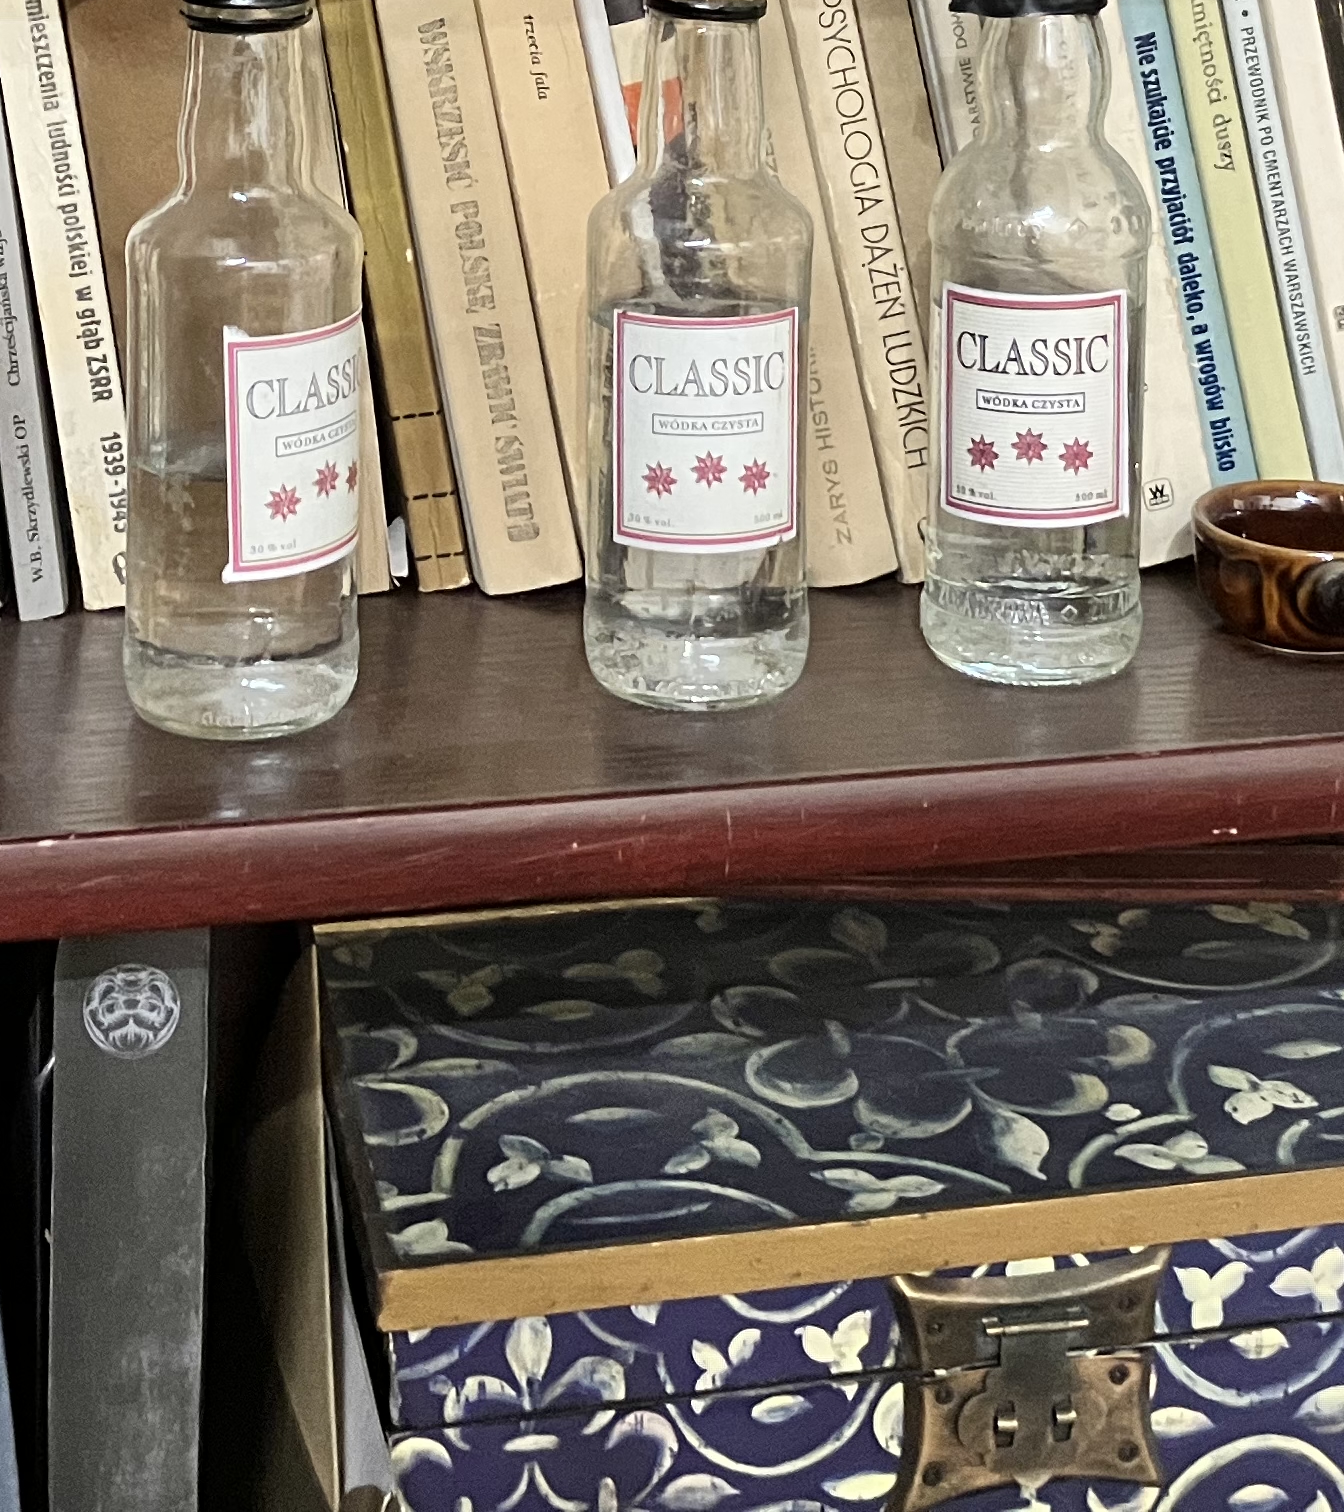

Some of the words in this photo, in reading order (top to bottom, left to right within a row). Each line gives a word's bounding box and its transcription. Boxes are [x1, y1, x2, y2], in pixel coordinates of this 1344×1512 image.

[523, 13, 543, 66] trzecia
[1133, 30, 1157, 66] Nie
[530, 71, 548, 101] fala
[1240, 25, 1270, 124] PRZEWODNIK
[1139, 67, 1173, 153] szukajcie
[1258, 126, 1275, 147] PO
[46, 118, 79, 199] ludności
[1212, 113, 1235, 173] duszy
[1153, 155, 1192, 245] przyjaciół
[1262, 148, 1295, 258] CMENTARZACH
[57, 192, 94, 278] polskiej
[74, 285, 94, 302] w
[860, 222, 906, 322] DĄŻEŃ
[1176, 251, 1206, 321] daleko,
[75, 305, 98, 351] głąb
[1192, 323, 1208, 336] a
[1283, 258, 1316, 377] WARSZAWSKICH
[84, 343, 114, 403] ZSRR
[627, 351, 786, 398] CLASSIC
[955, 331, 1110, 377] CLASSIC
[1193, 337, 1226, 413] wrogów
[13, 414, 28, 439] OP
[658, 417, 709, 432] WÓDKA
[711, 416, 760, 431] CZYSTA
[882, 333, 930, 470] LUDZKICH
[981, 394, 1029, 410] WÓDKA
[1031, 396, 1081, 411] CZYSTA
[282, 431, 327, 452] WÓDKA
[1209, 416, 1237, 473] blisko
[16, 445, 42, 543] Skrzydlewski
[821, 460, 854, 547] ZARYS
